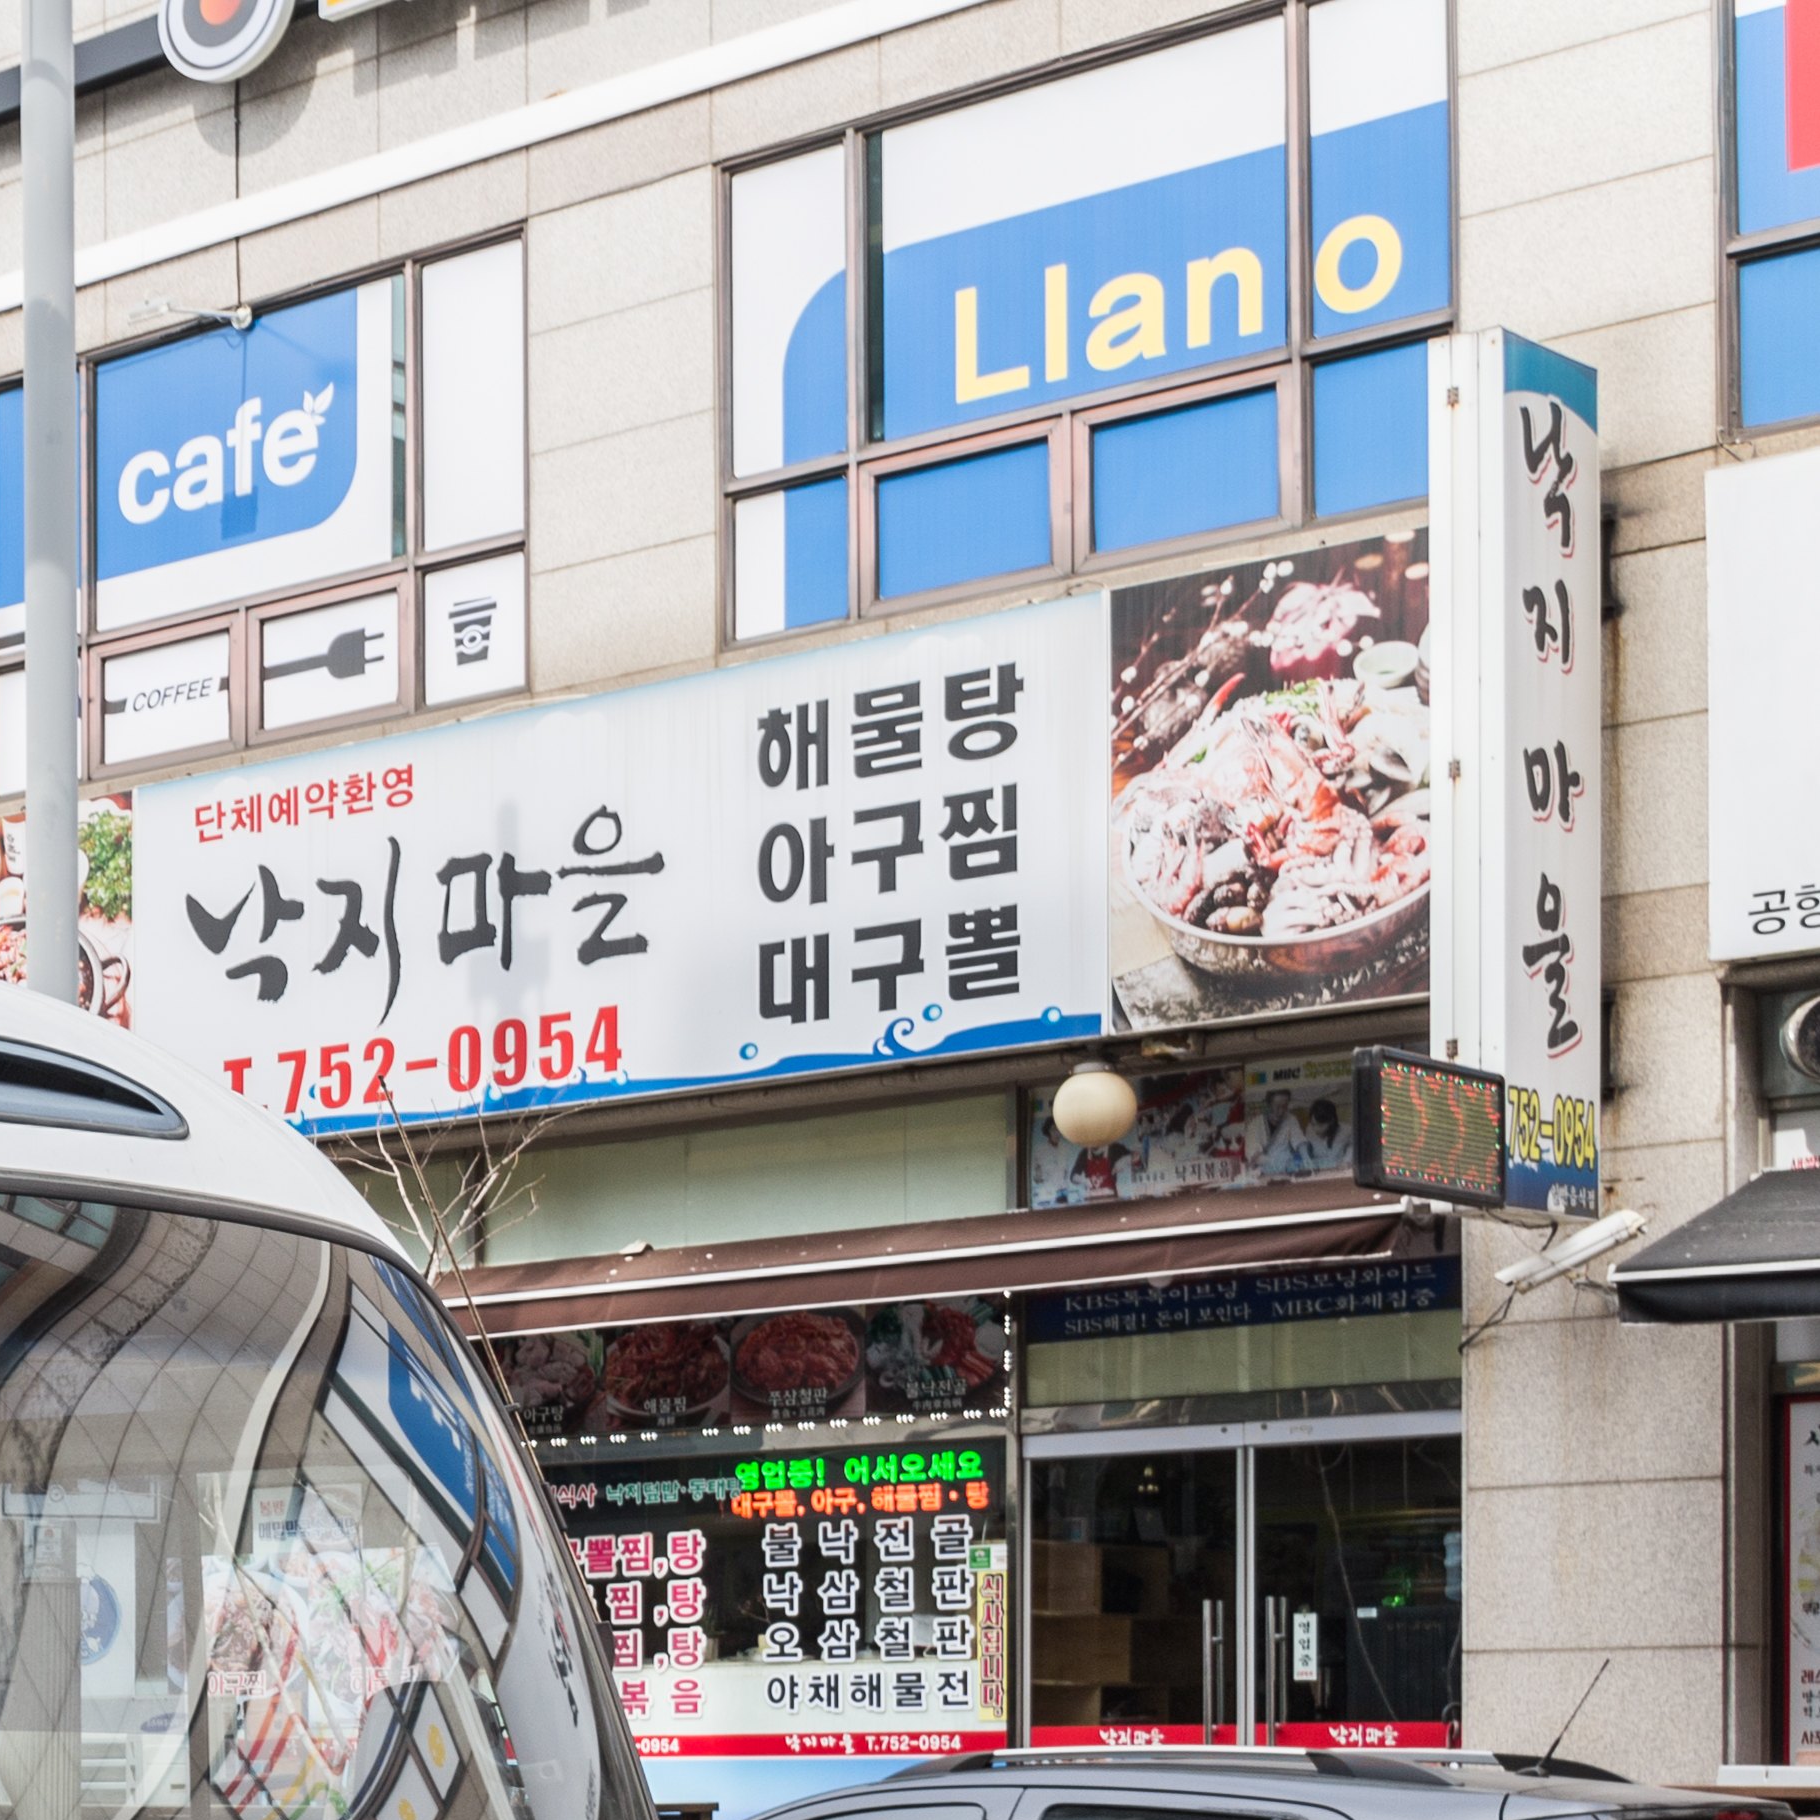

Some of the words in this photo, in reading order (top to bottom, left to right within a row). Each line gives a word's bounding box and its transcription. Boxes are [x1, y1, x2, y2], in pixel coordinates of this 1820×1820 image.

[955, 214, 1404, 406] Llano
[130, 675, 214, 715] COFFEE
[755, 661, 1027, 794] 해물탕
[1518, 394, 1585, 1060] 낙지마을
[192, 762, 418, 847] 단체예약환영
[755, 782, 1023, 907] 아구찜
[183, 801, 666, 1028] 낙지마을
[755, 902, 1025, 1027] 대구뽈
[222, 1004, 624, 1116] T.752-0954
[1508, 1084, 1596, 1171] 752-0954
[523, 1405, 565, 1424] 아구탕
[643, 1396, 688, 1414] 해물찜
[551, 1482, 598, 1510] 식사
[734, 1457, 826, 1492] 영업중!
[844, 1450, 984, 1485] 어서오세요
[762, 1515, 972, 1567] 불낙전골
[763, 1565, 975, 1616] 낙삼철판
[762, 1613, 975, 1663] 오삼철판
[979, 1573, 1004, 1718] 식사됩니다
[766, 1667, 973, 1713] 야채해물전
[784, 1733, 855, 1755] 낙지마을
[865, 1733, 962, 1752] T.752-0954
[1327, 1725, 1399, 1748] 낙지마을
